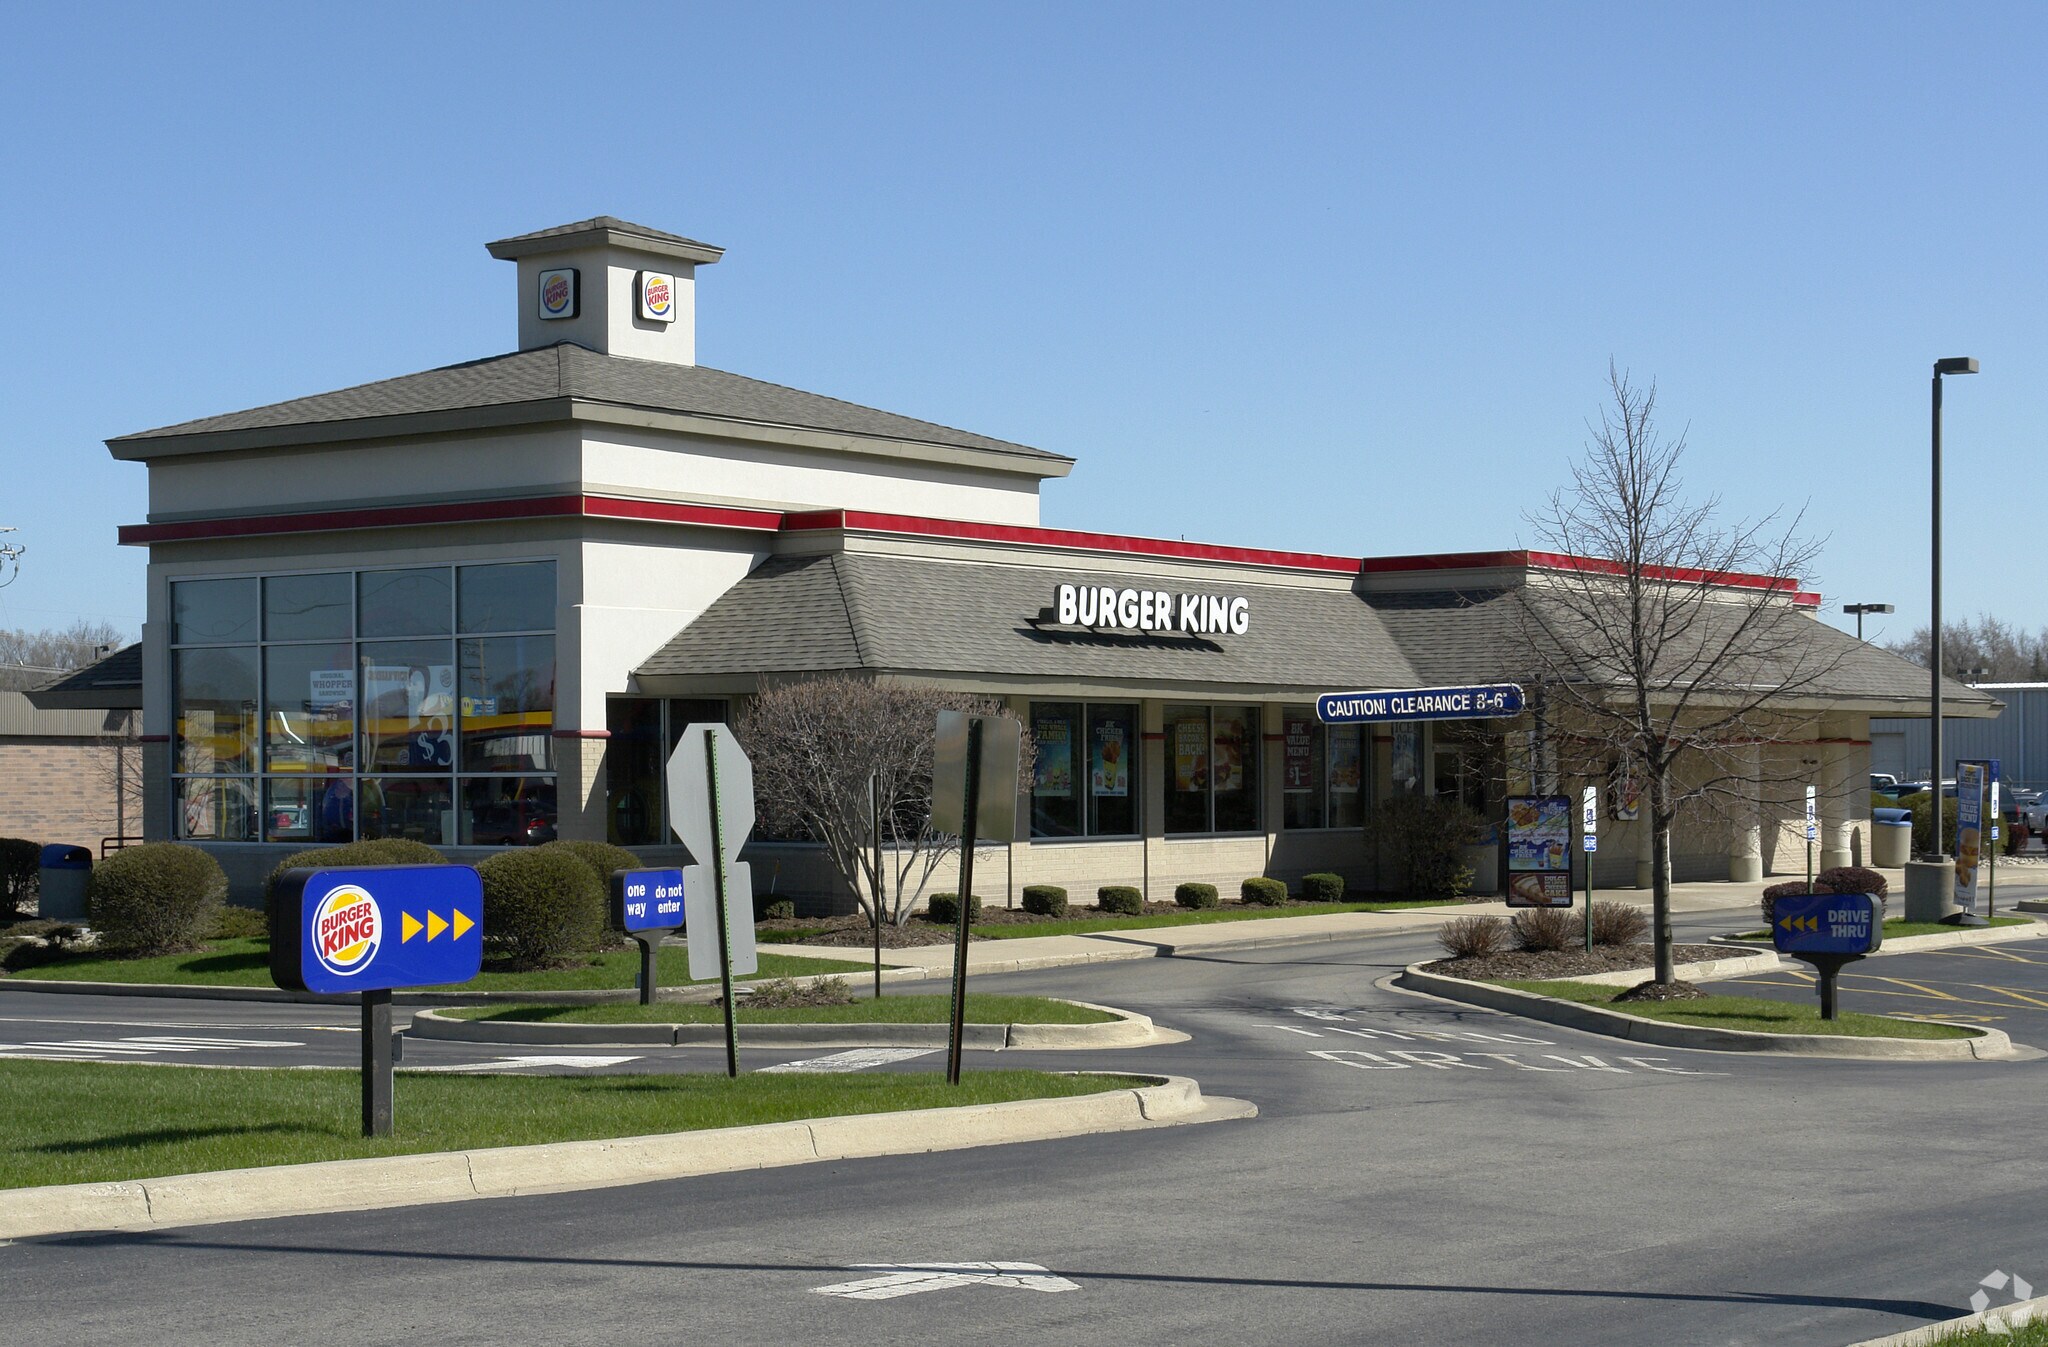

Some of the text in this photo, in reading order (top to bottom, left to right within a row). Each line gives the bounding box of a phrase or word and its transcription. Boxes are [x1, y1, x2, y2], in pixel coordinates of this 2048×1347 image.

[545, 280, 568, 294] BURGER
[647, 284, 669, 296] BURGER
[546, 287, 569, 306] KING
[648, 291, 669, 306] KING
[1058, 584, 1249, 635] BURGER KING
[312, 680, 353, 688] WHOPPER
[1327, 699, 1386, 717] CAUTION!
[1391, 694, 1471, 714] CLEARANCE
[1037, 730, 1067, 740] FAMILY
[1177, 723, 1206, 733] CHEESY
[1291, 723, 1304, 734] BK
[1286, 735, 1311, 745] VALUE
[1178, 744, 1205, 755] BACK!
[1287, 747, 1310, 757] MENU
[627, 884, 646, 897] one
[655, 883, 682, 898] do not
[627, 902, 647, 918] way
[657, 900, 681, 913] enter
[321, 902, 372, 935] BURGER
[1828, 910, 1870, 923] DRIVE
[323, 917, 374, 958] KING
[1830, 924, 1867, 938] THRU
[1251, 1024, 1556, 1045] THRU
[1305, 1050, 1732, 1076] DRIVE
